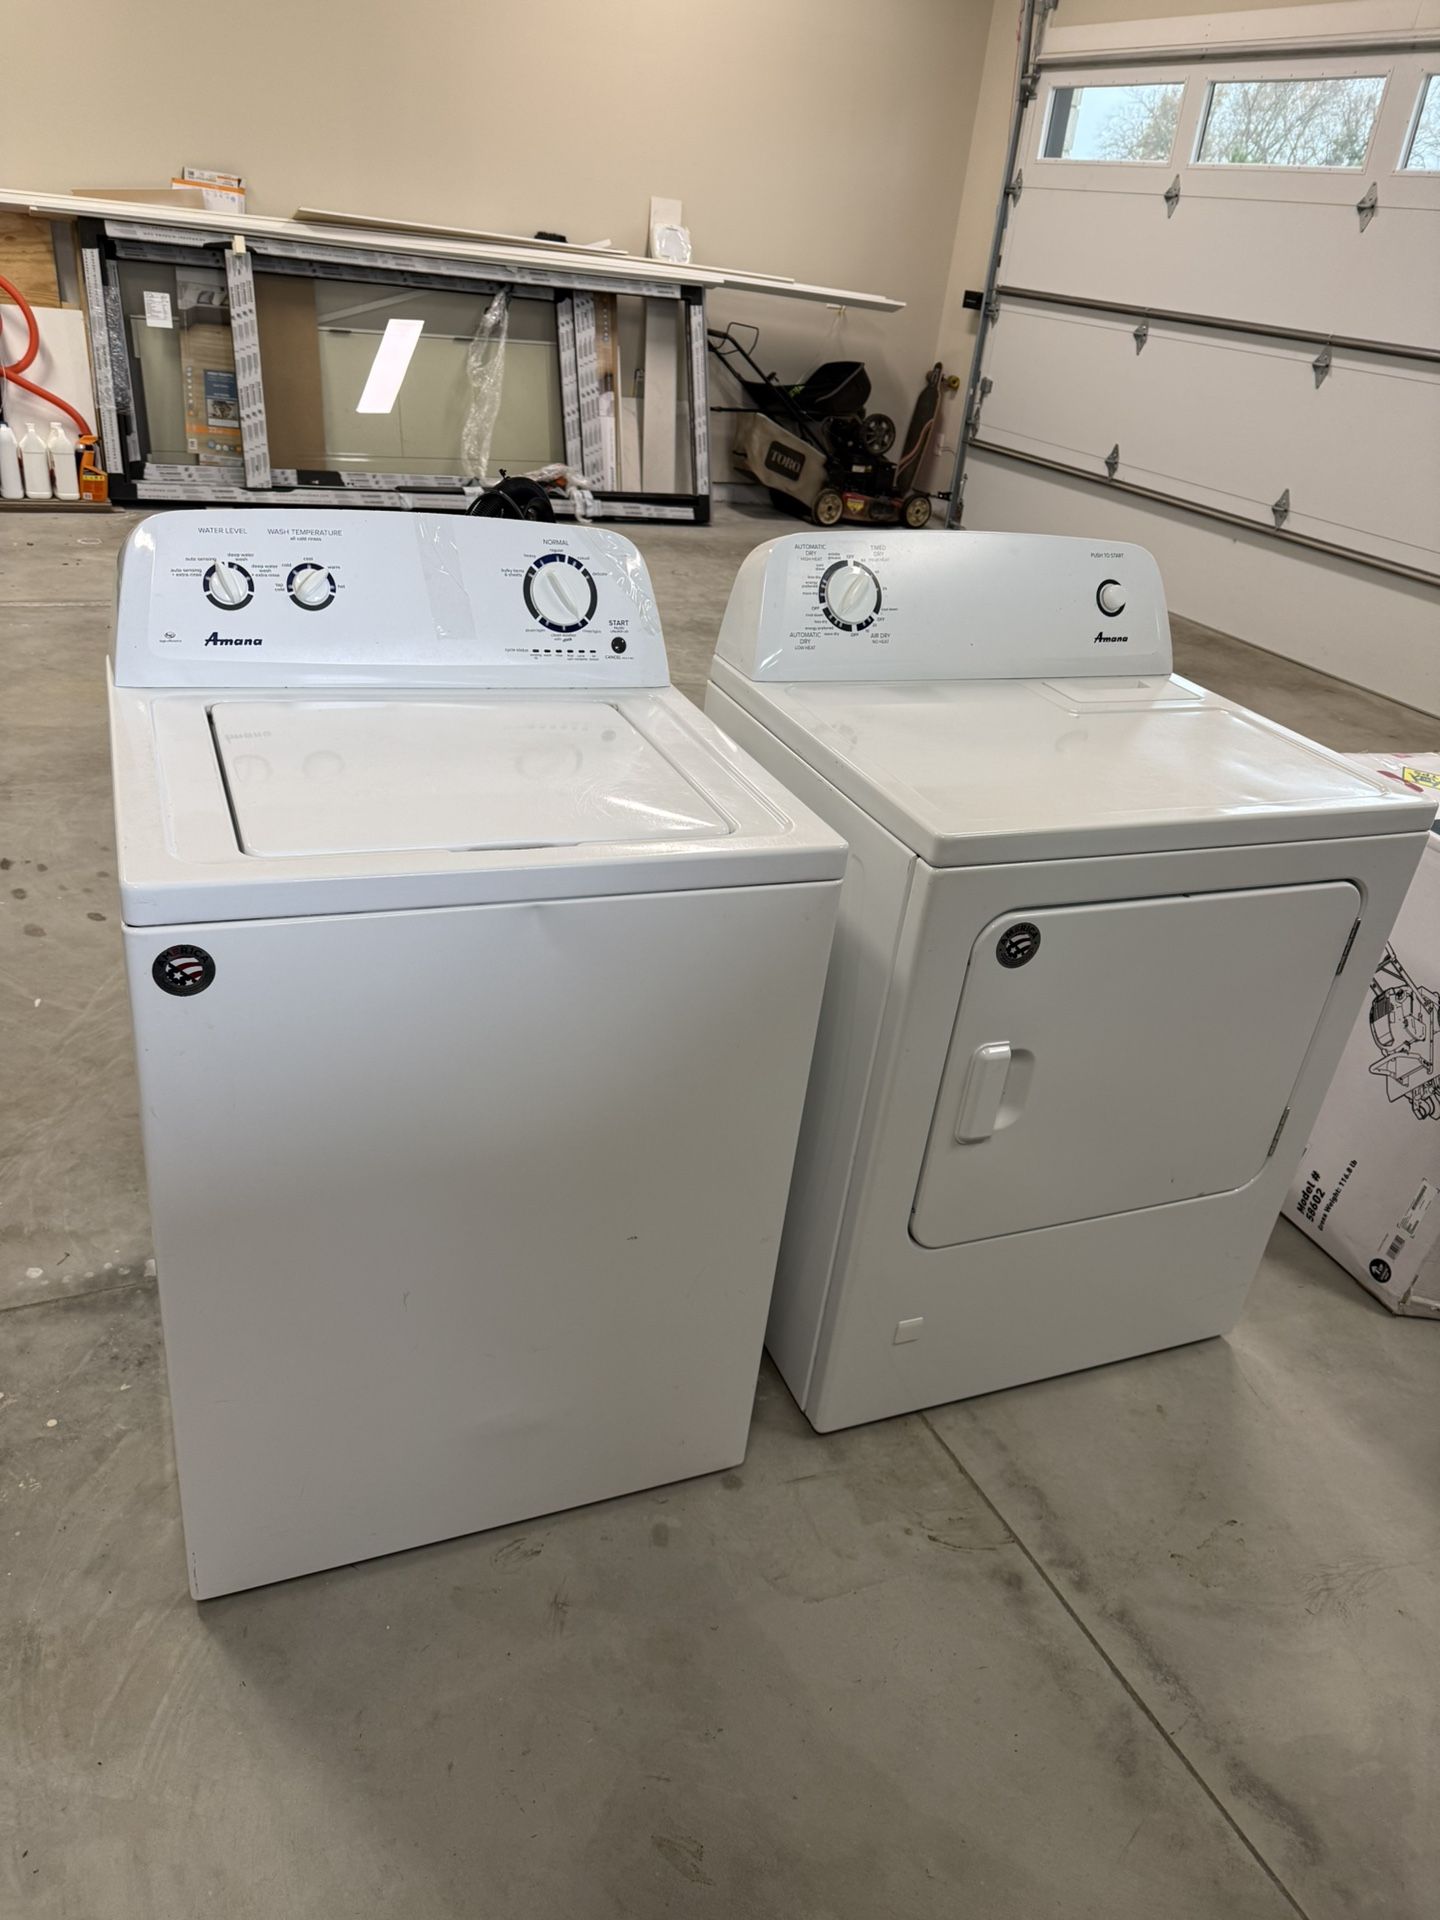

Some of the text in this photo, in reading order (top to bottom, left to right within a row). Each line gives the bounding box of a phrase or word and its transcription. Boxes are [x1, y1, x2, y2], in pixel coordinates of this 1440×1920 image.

[771, 450, 801, 472] TORO
[198, 527, 248, 535] WATER LEVEL
[268, 528, 343, 537] WASH TEMPERATURE
[204, 631, 263, 647] Amana
[1093, 631, 1128, 643] Amana
[1296, 1170, 1321, 1215] Model #
[1324, 1188, 1341, 1213] Weight:
[1350, 1159, 1358, 1168] lb
[1305, 1187, 1326, 1222] 58602
